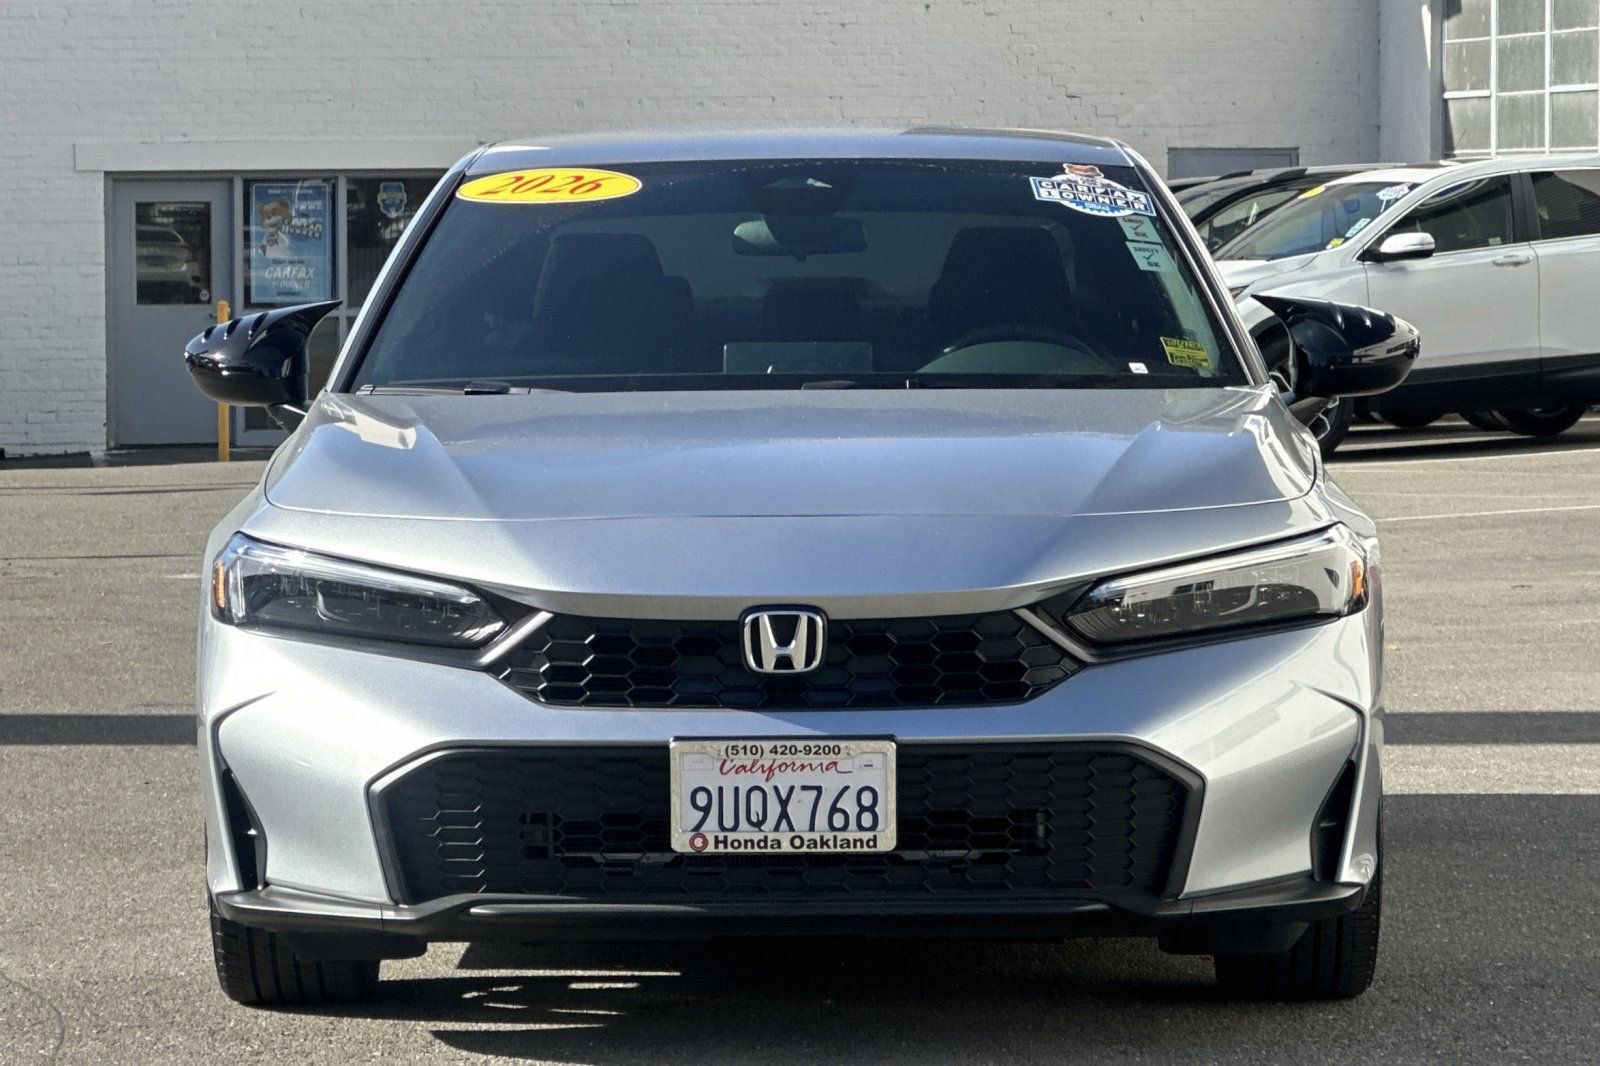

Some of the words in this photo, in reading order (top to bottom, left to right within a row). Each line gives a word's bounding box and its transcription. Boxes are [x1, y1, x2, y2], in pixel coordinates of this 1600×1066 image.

[477, 174, 620, 196] 2026
[1040, 180, 1146, 202] CARFAX
[264, 266, 316, 279] CARFAX
[725, 744, 764, 759] (510)
[769, 744, 841, 756] 420-9200
[719, 758, 853, 782] California
[690, 784, 879, 832] 9UQX768
[713, 834, 782, 850] Honda
[789, 834, 878, 849] Oakland
